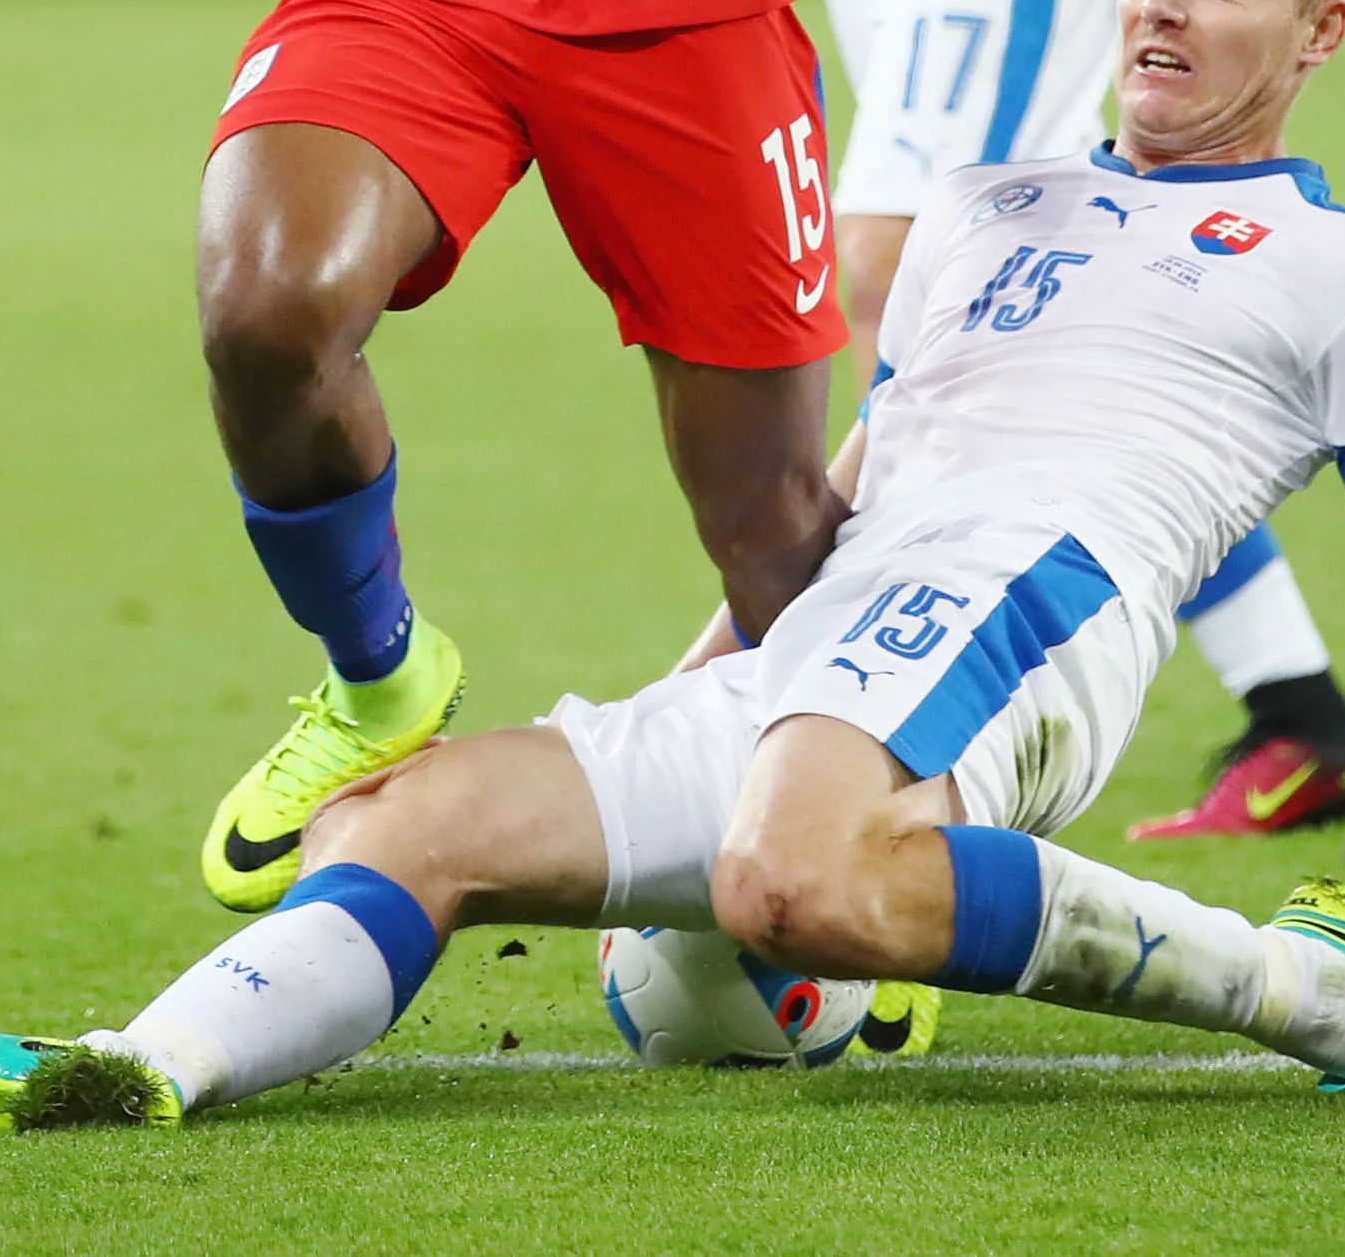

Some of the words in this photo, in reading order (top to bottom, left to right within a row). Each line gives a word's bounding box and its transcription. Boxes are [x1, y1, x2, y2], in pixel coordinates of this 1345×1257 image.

[901, 13, 990, 112] 17
[760, 113, 826, 263] 15
[960, 245, 1094, 333] 15
[839, 582, 971, 660] 15
[215, 957, 270, 993] SVK
